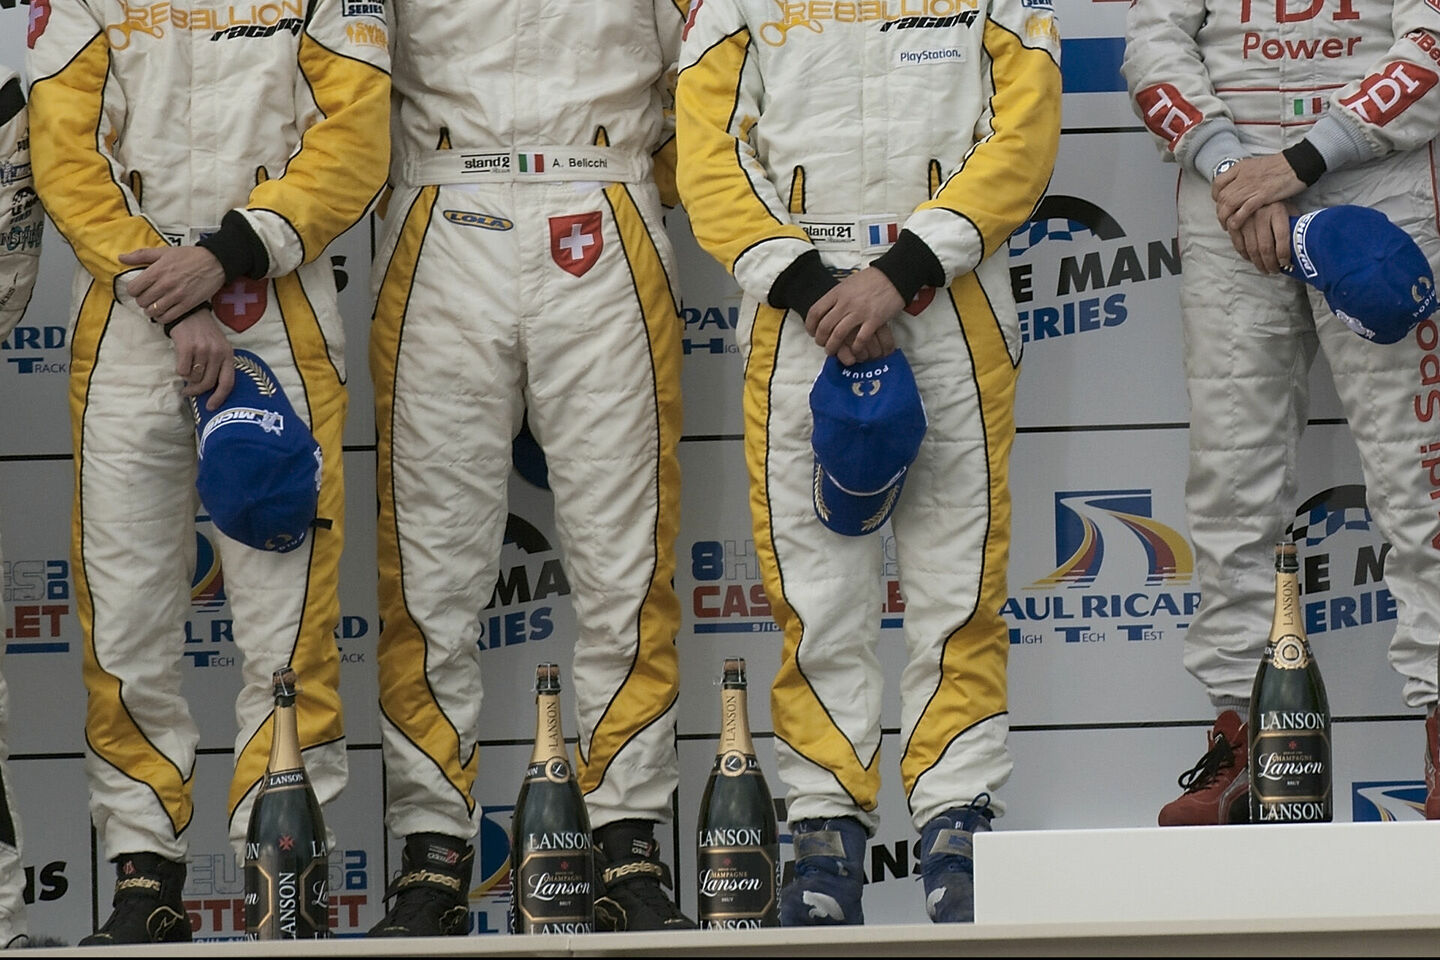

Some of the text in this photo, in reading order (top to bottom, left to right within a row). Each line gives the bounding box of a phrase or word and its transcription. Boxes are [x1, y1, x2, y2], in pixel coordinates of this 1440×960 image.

[210, 17, 303, 41] racing
[880, 10, 980, 33] racing
[1243, 32, 1362, 60] Power
[1351, 64, 1420, 122] TDI
[569, 157, 608, 170] Belicchi
[450, 213, 506, 228] LOLA
[843, 364, 889, 379] PODIUM
[1283, 579, 1294, 626] LANSON
[1260, 712, 1325, 730] LANSON
[1258, 754, 1325, 780] Lanson
[270, 774, 304, 786] LANSON
[1259, 802, 1324, 821] LANSON
[529, 832, 591, 851] LANSON
[527, 872, 590, 900] Lanson
